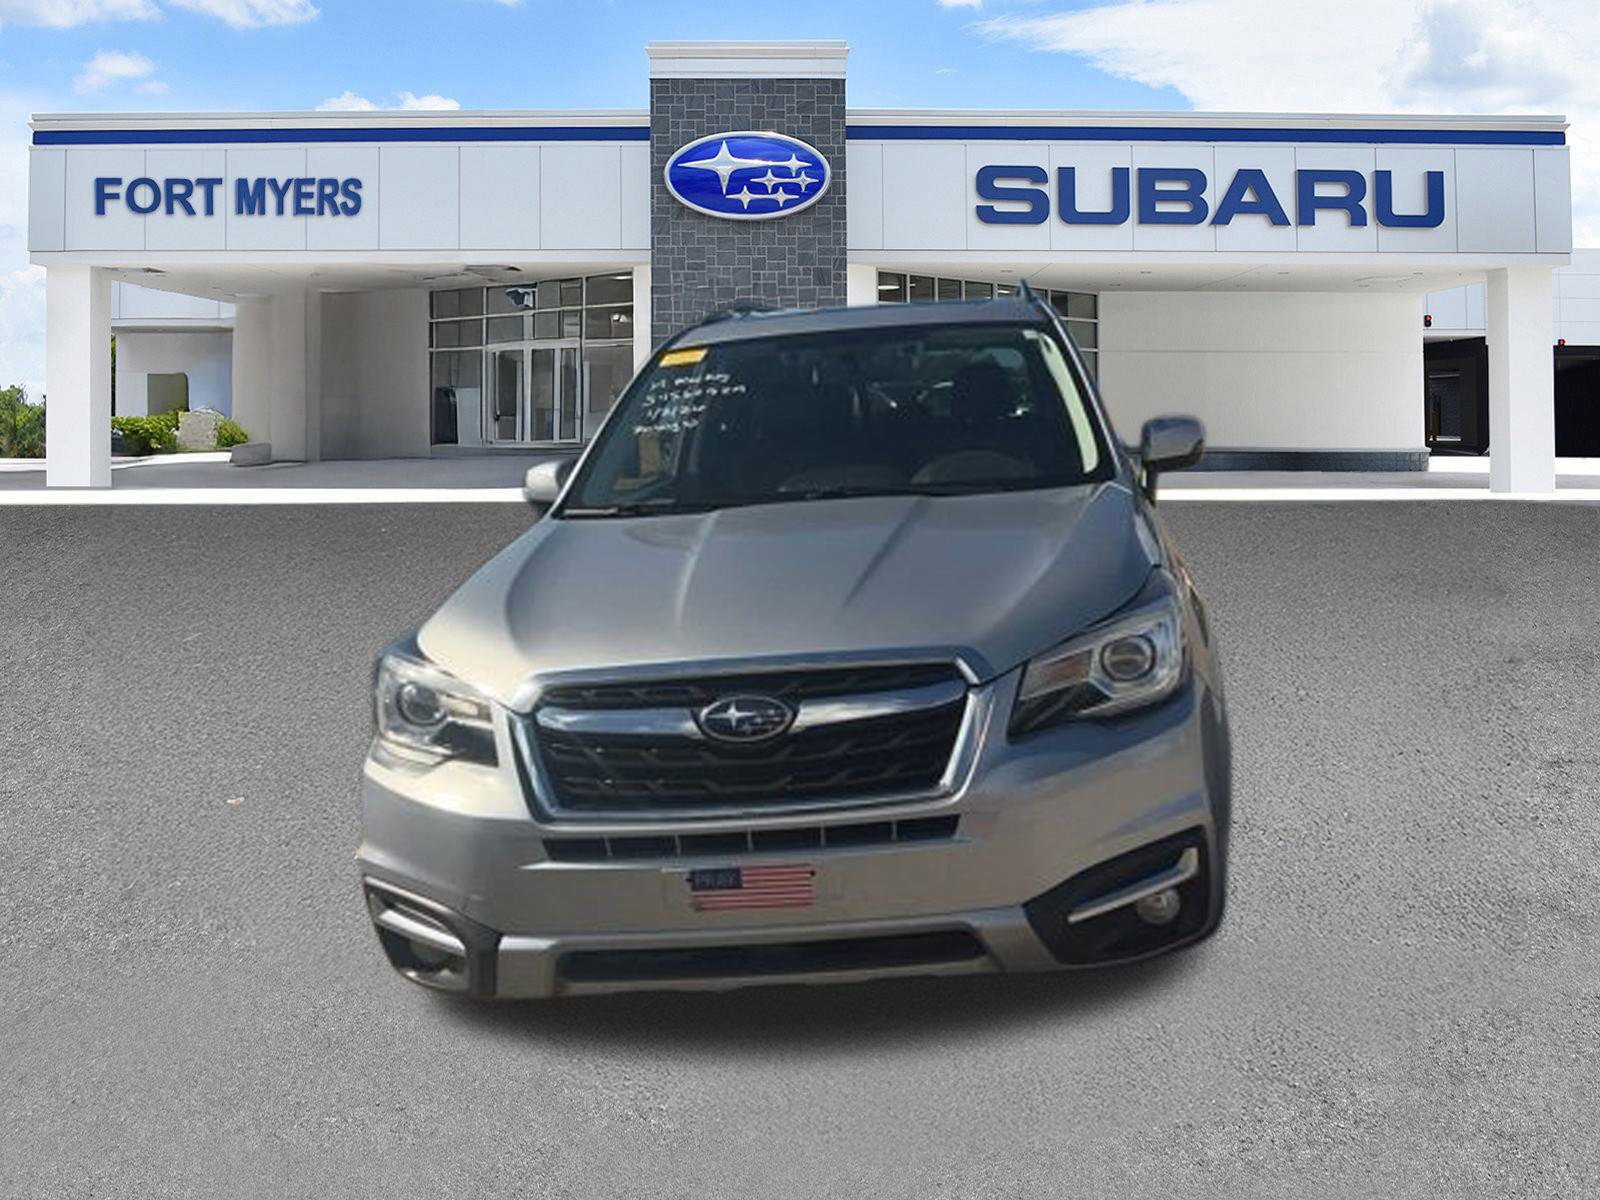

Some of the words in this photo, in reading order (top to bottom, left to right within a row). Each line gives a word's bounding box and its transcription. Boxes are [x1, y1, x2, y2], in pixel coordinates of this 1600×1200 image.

[94, 177, 223, 216] FORT
[235, 177, 363, 217] MYERS
[975, 165, 1446, 228] SUBARU
